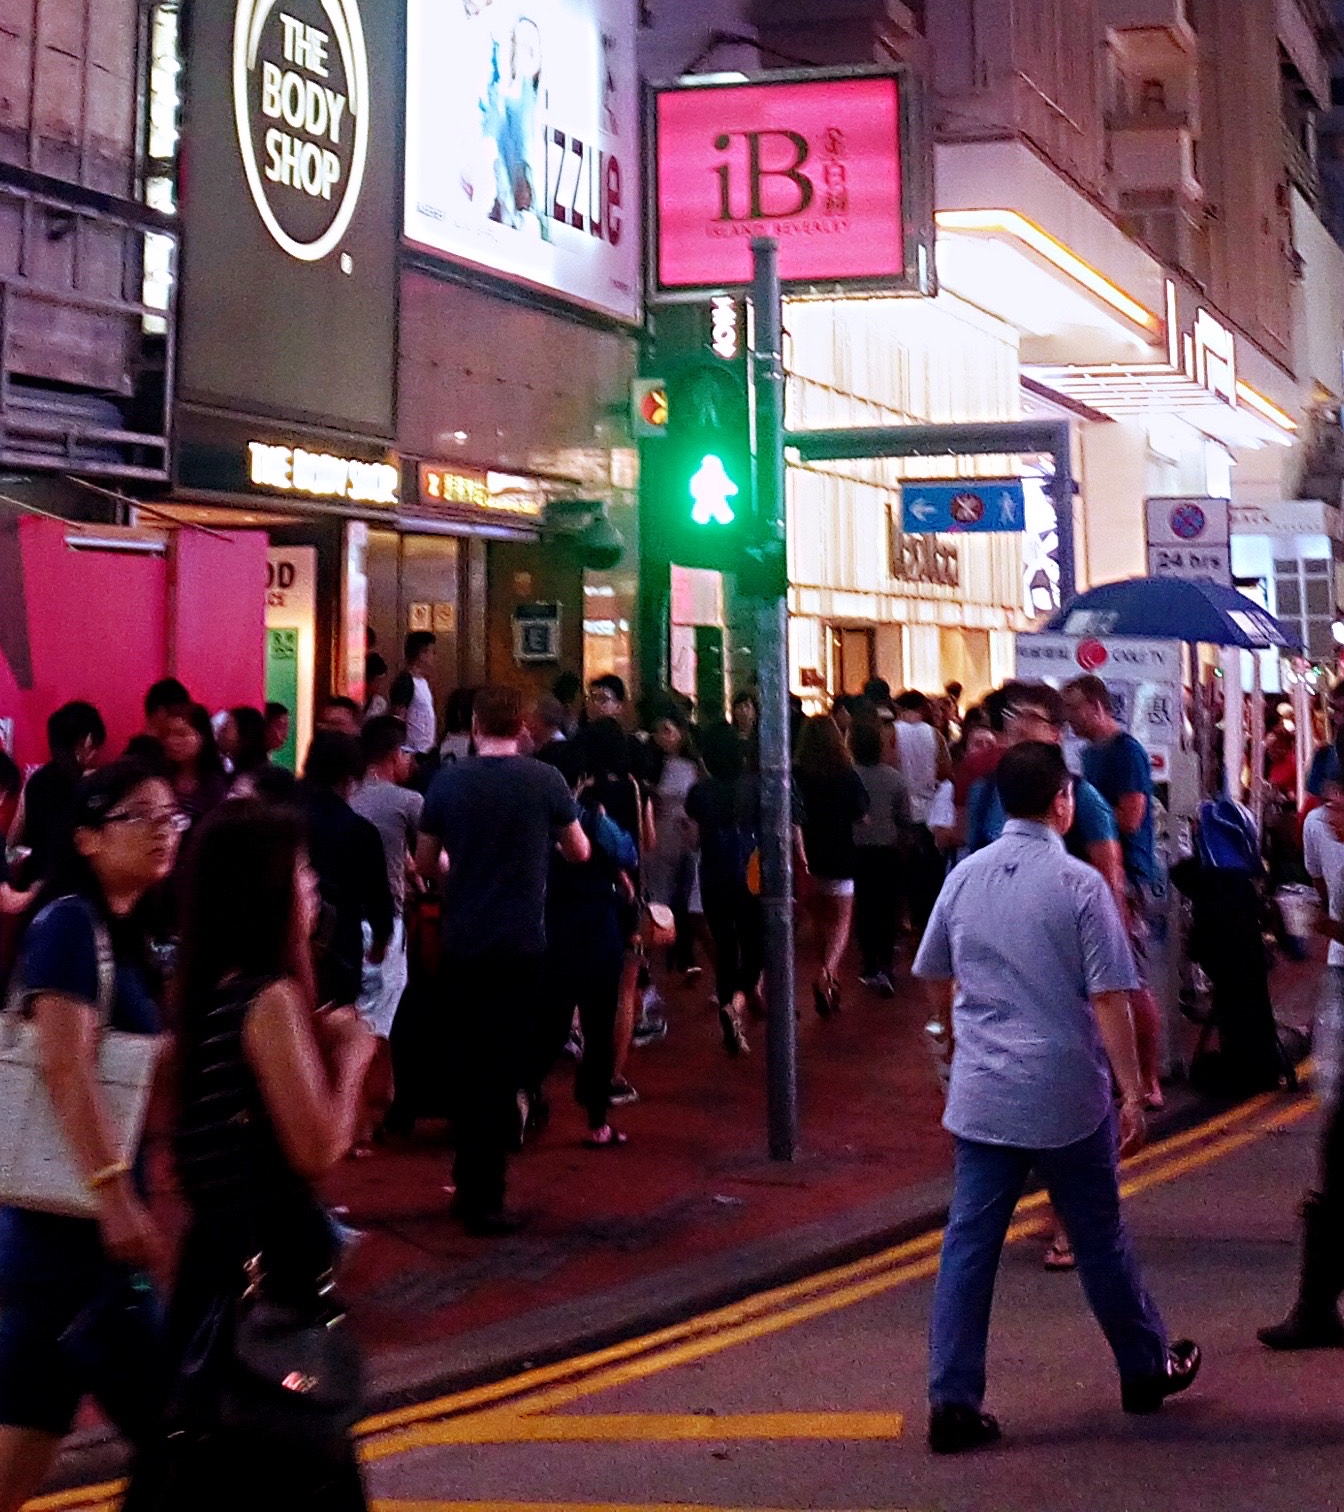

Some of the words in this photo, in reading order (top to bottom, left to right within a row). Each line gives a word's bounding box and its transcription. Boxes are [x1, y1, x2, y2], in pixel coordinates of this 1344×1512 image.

[278, 12, 330, 78] THE
[262, 64, 346, 143] BODY
[264, 131, 342, 201] SHOP
[710, 130, 814, 222] iB
[1157, 551, 1183, 568] 24
